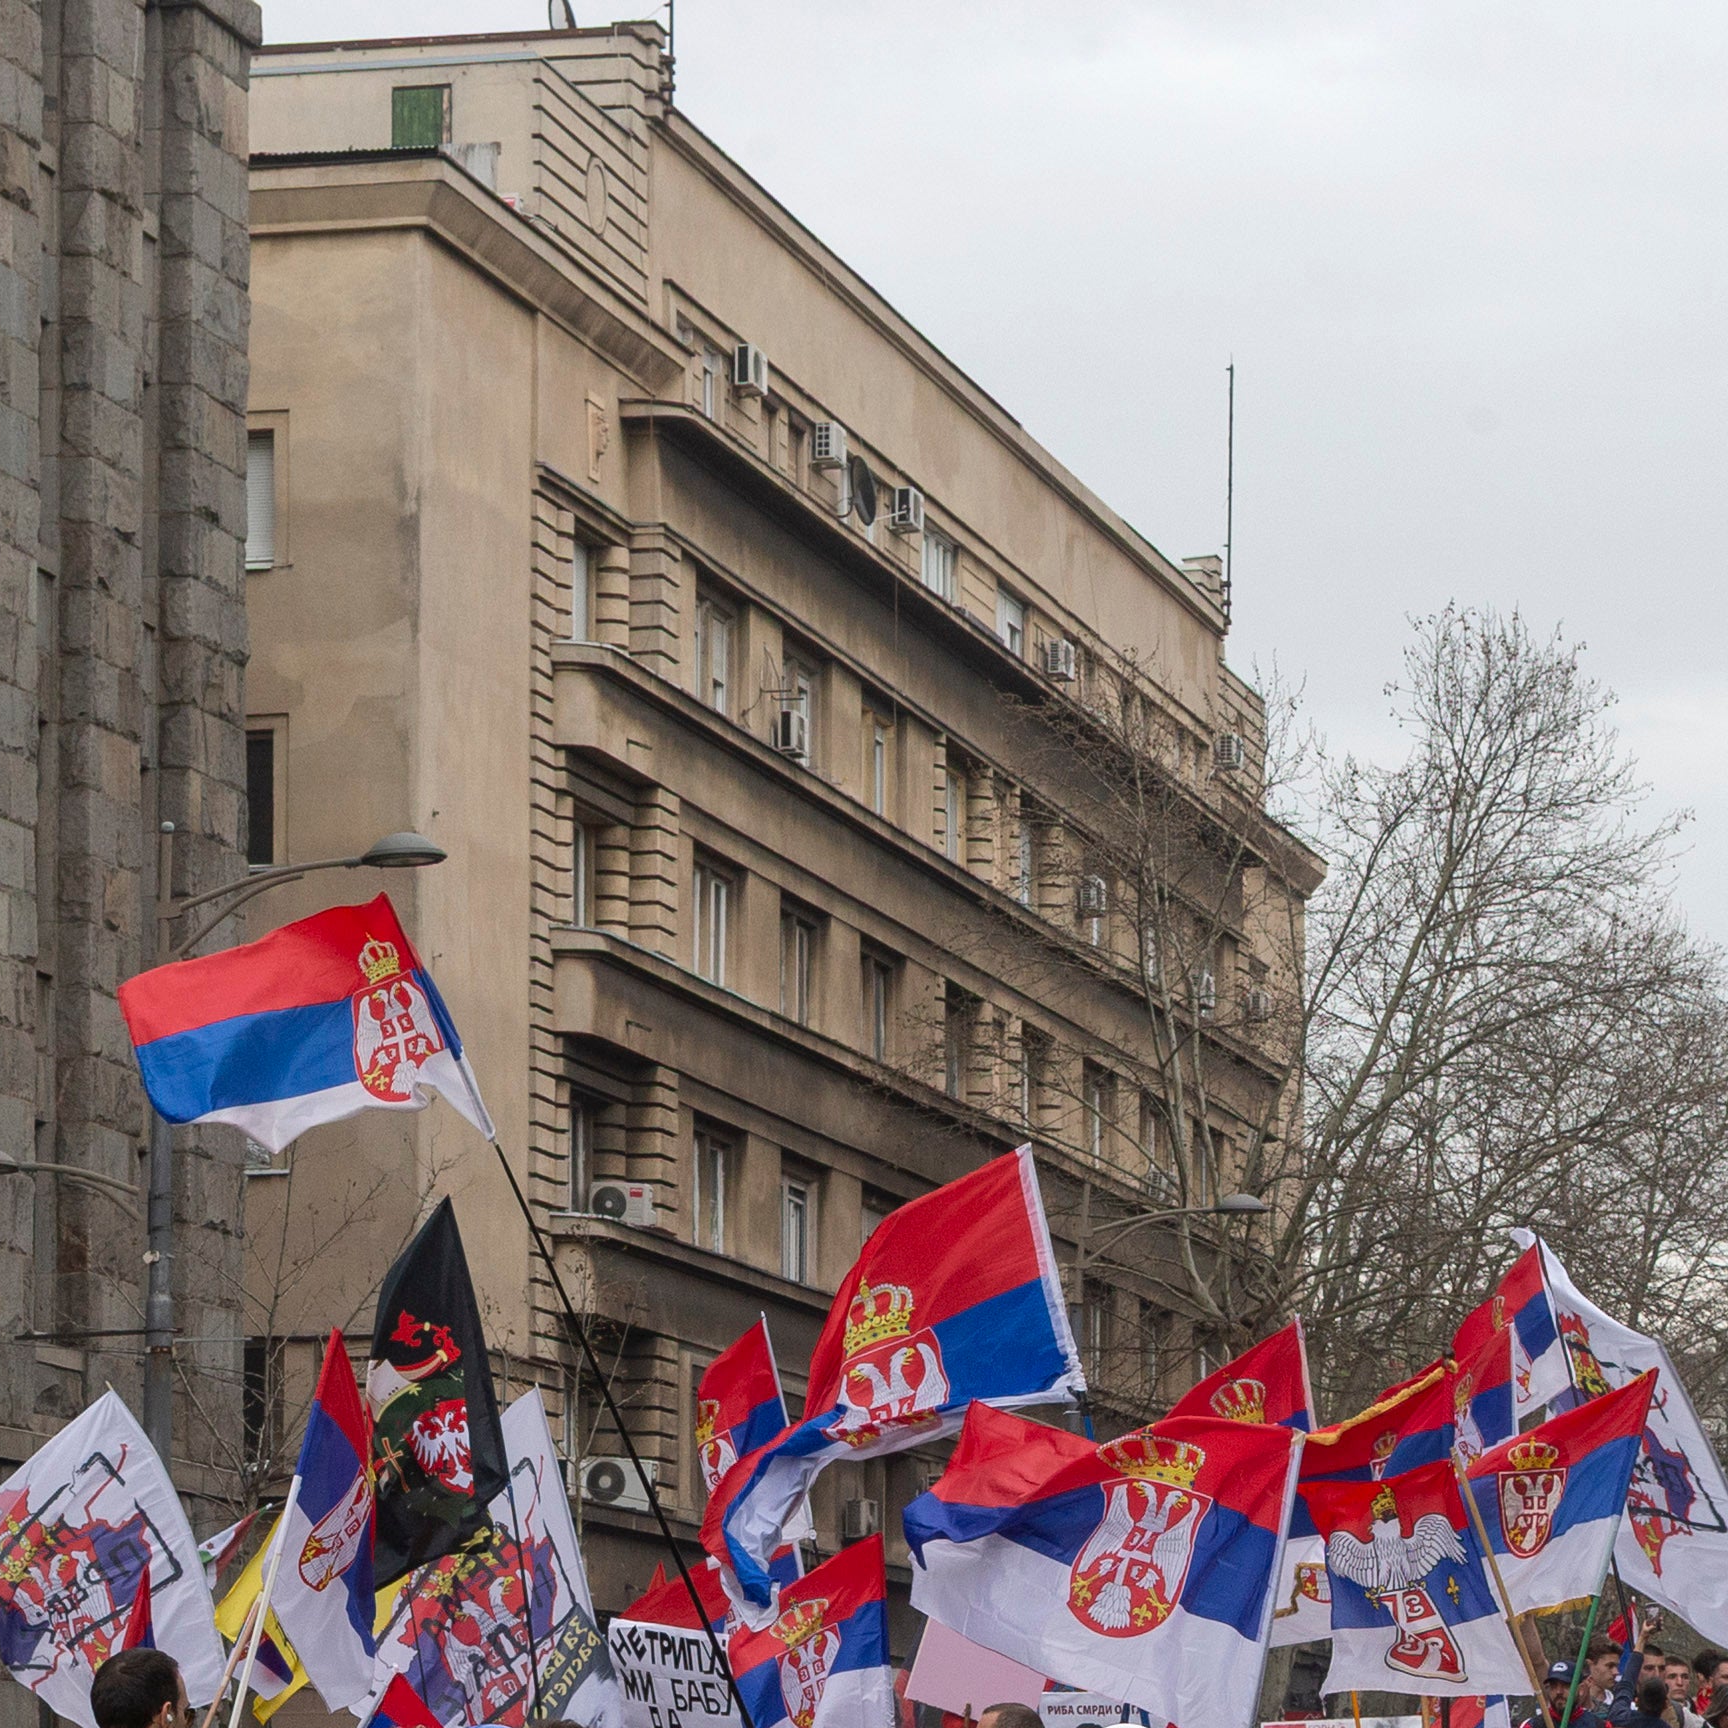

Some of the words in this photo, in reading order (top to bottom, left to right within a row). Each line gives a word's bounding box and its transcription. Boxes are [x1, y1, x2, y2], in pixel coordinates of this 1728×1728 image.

[620, 1668, 656, 1704] МИ
[671, 1679, 733, 1716] БАБУ
[1047, 1705, 1074, 1716] РИБА
[1076, 1705, 1112, 1716] СМРДИ
